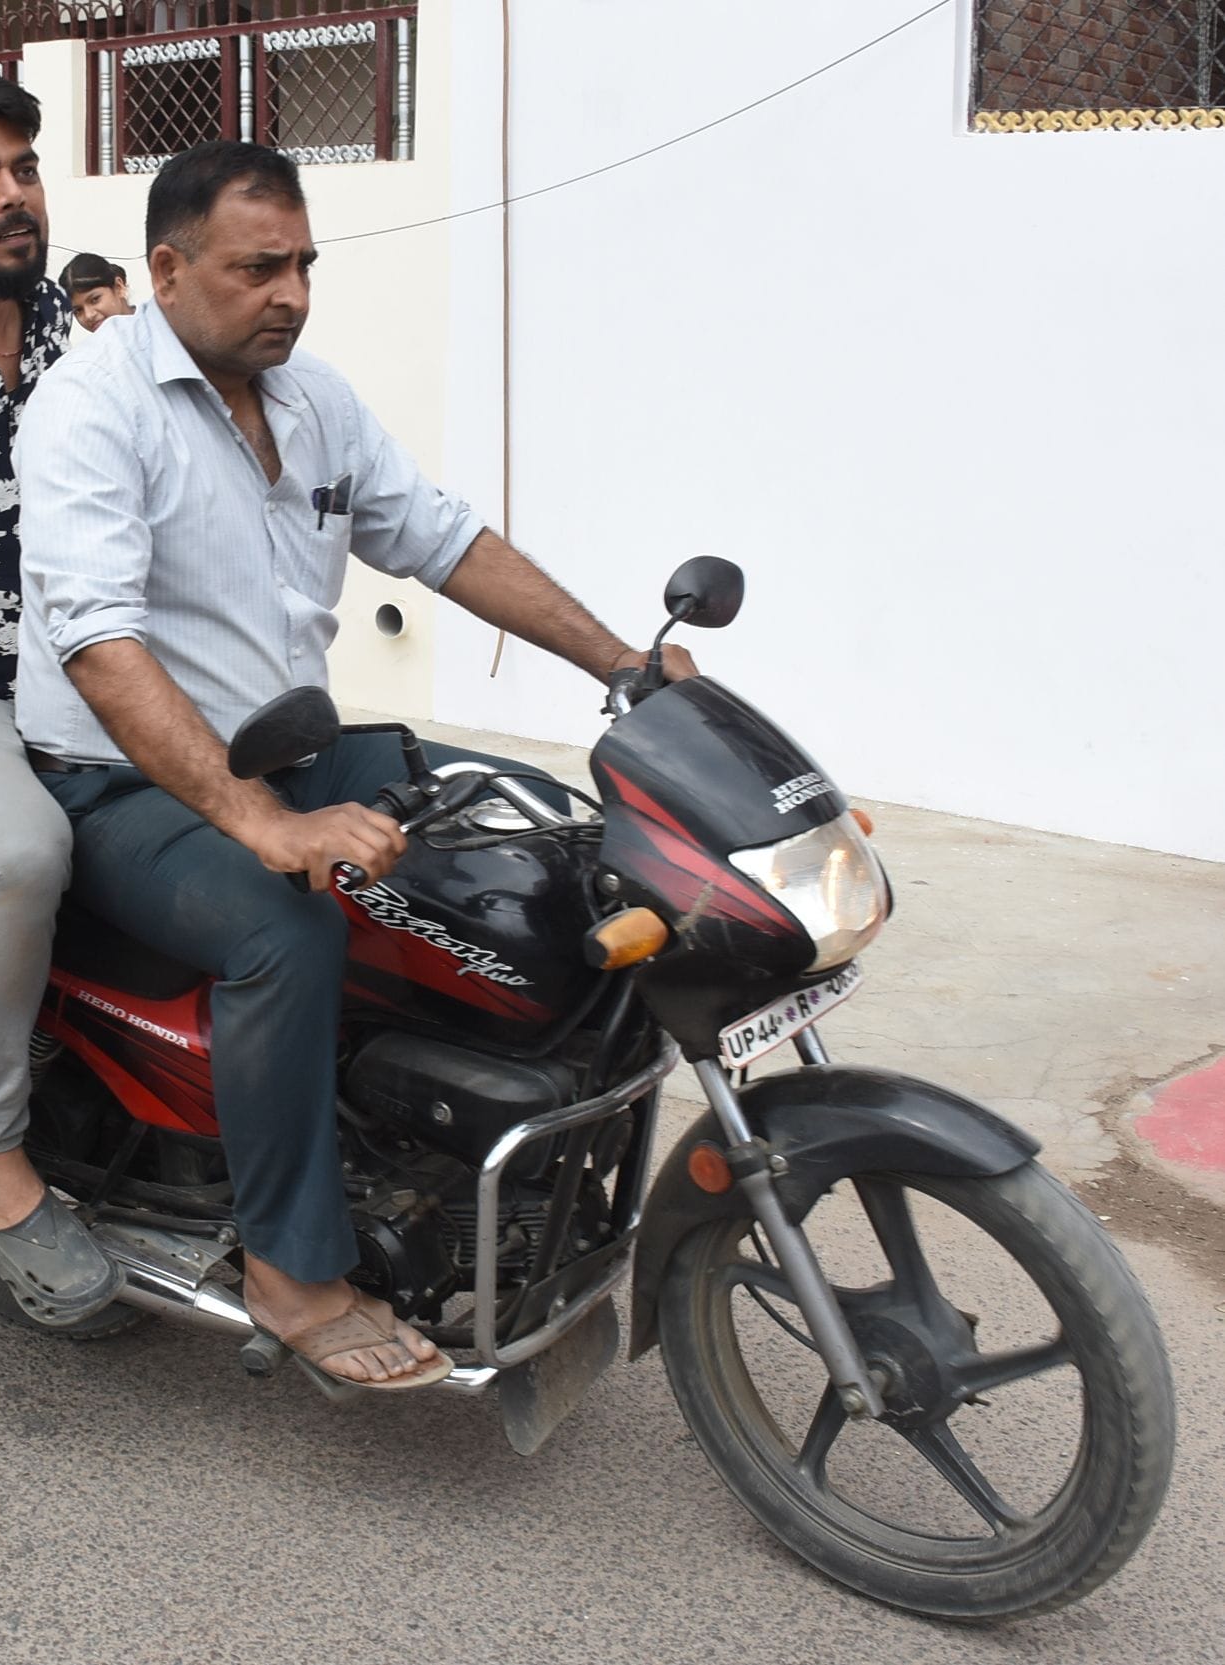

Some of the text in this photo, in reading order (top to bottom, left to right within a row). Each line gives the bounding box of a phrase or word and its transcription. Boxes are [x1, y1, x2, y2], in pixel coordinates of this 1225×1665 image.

[768, 771, 824, 800] HERO
[772, 781, 837, 815] HONDA
[76, 989, 190, 1050] HERO HONDA
